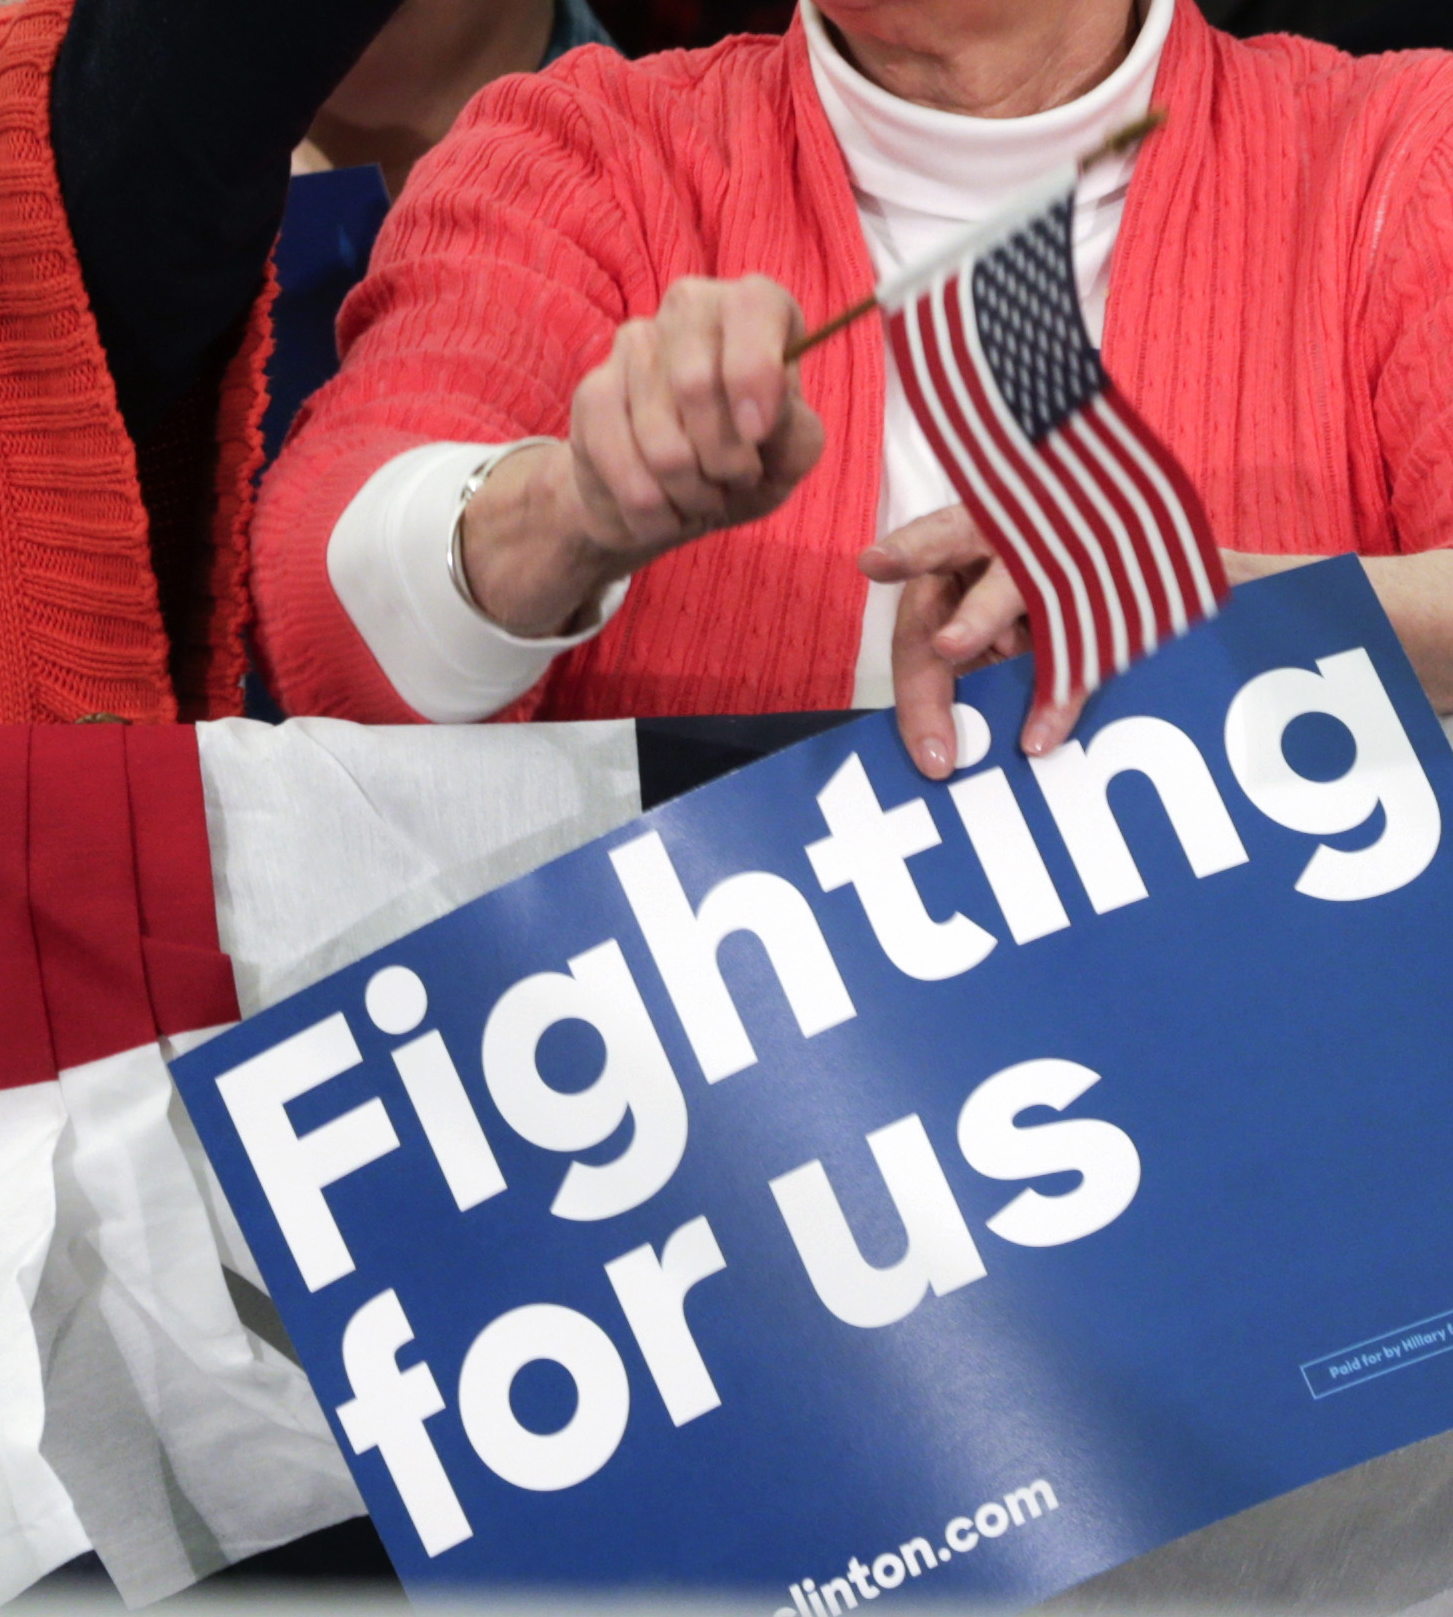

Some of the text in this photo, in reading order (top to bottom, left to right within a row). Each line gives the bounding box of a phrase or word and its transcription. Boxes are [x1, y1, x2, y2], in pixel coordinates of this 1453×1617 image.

[215, 647, 1442, 1294] Fighting
[335, 1057, 1141, 1558] for us
[1328, 1329, 1447, 1379] Paid for by Hillary
[772, 1478, 1060, 1617] linton.com
